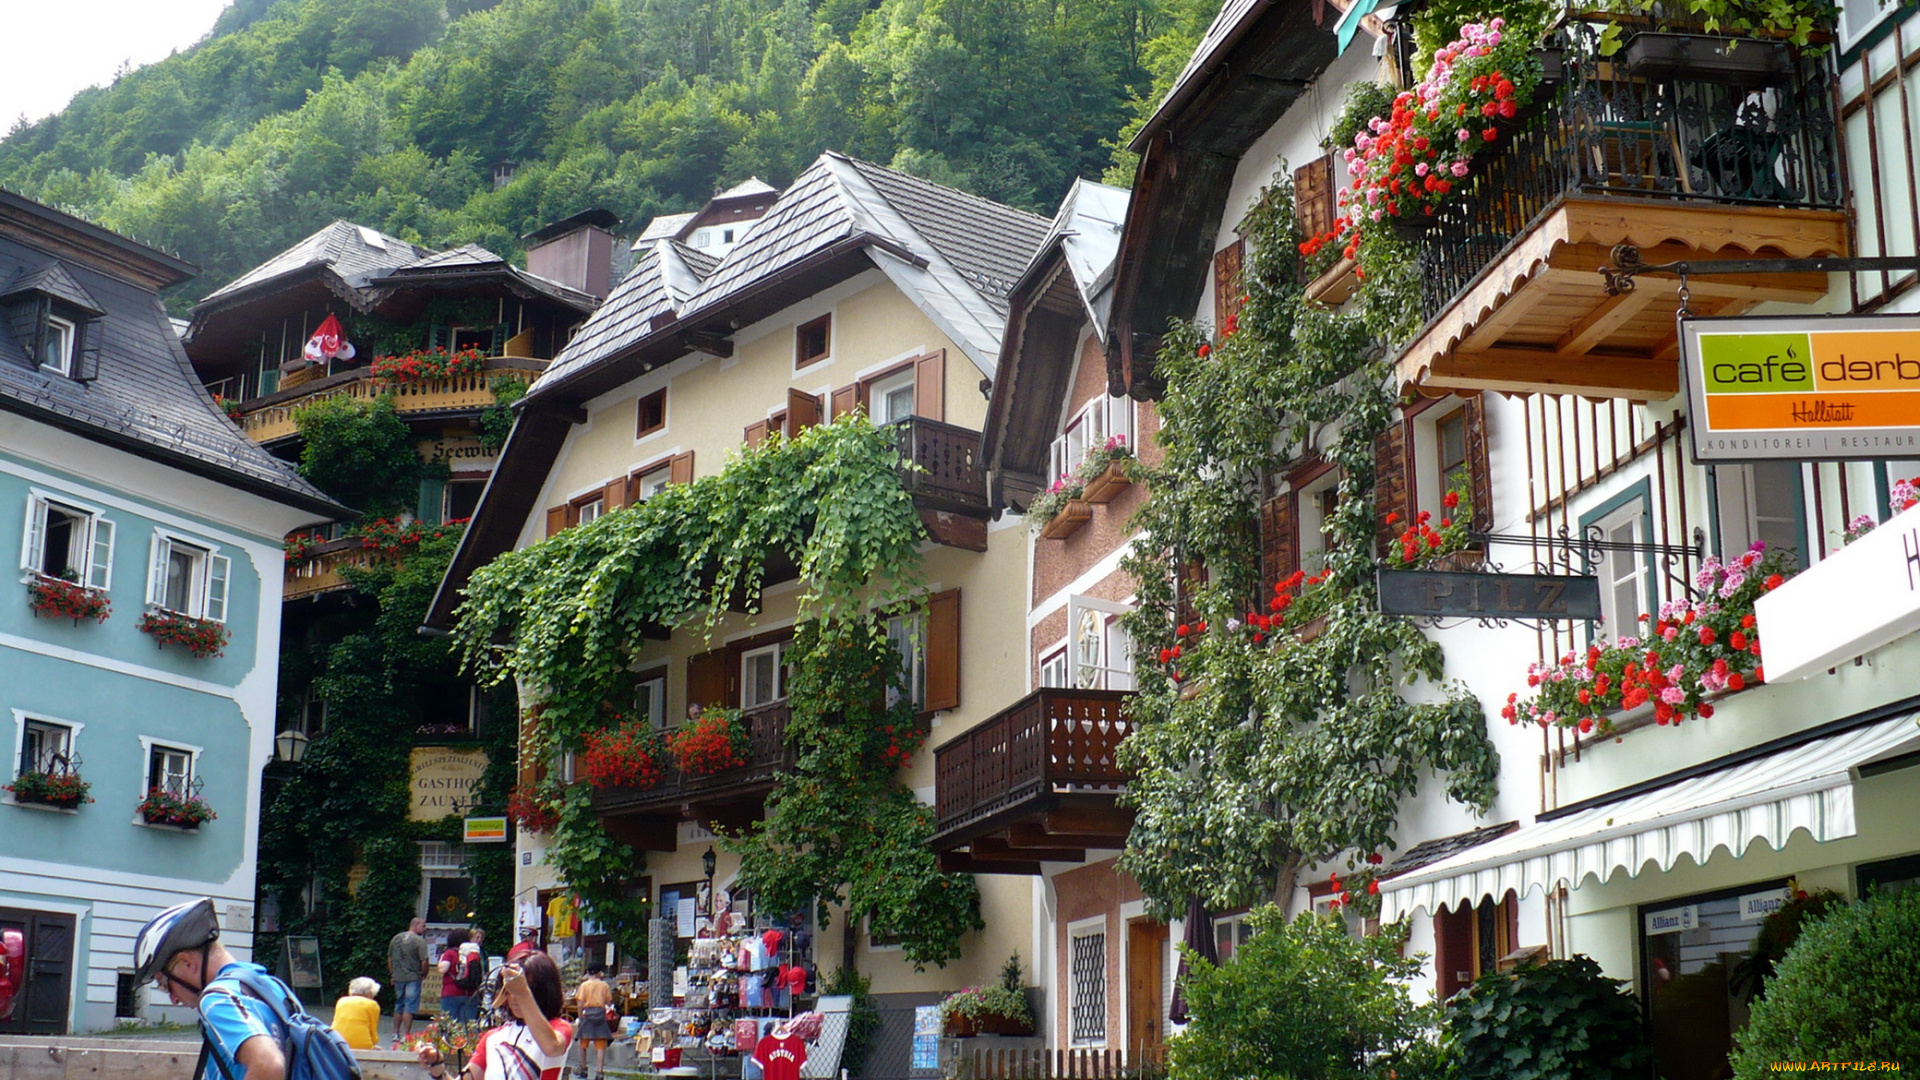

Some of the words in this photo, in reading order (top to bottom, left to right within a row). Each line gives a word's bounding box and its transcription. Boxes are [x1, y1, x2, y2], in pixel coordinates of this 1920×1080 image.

[1791, 400, 1857, 423] Hallstatt
[1707, 437, 1811, 450] KONDITOREI
[1841, 436, 1915, 448] RESTAUR
[1420, 577, 1568, 613] PILZ
[418, 777, 481, 789] GASTHO
[1747, 898, 1781, 914] Allianz
[1651, 916, 1680, 930] Allianz
[768, 1048, 795, 1063] AUSTRIA
